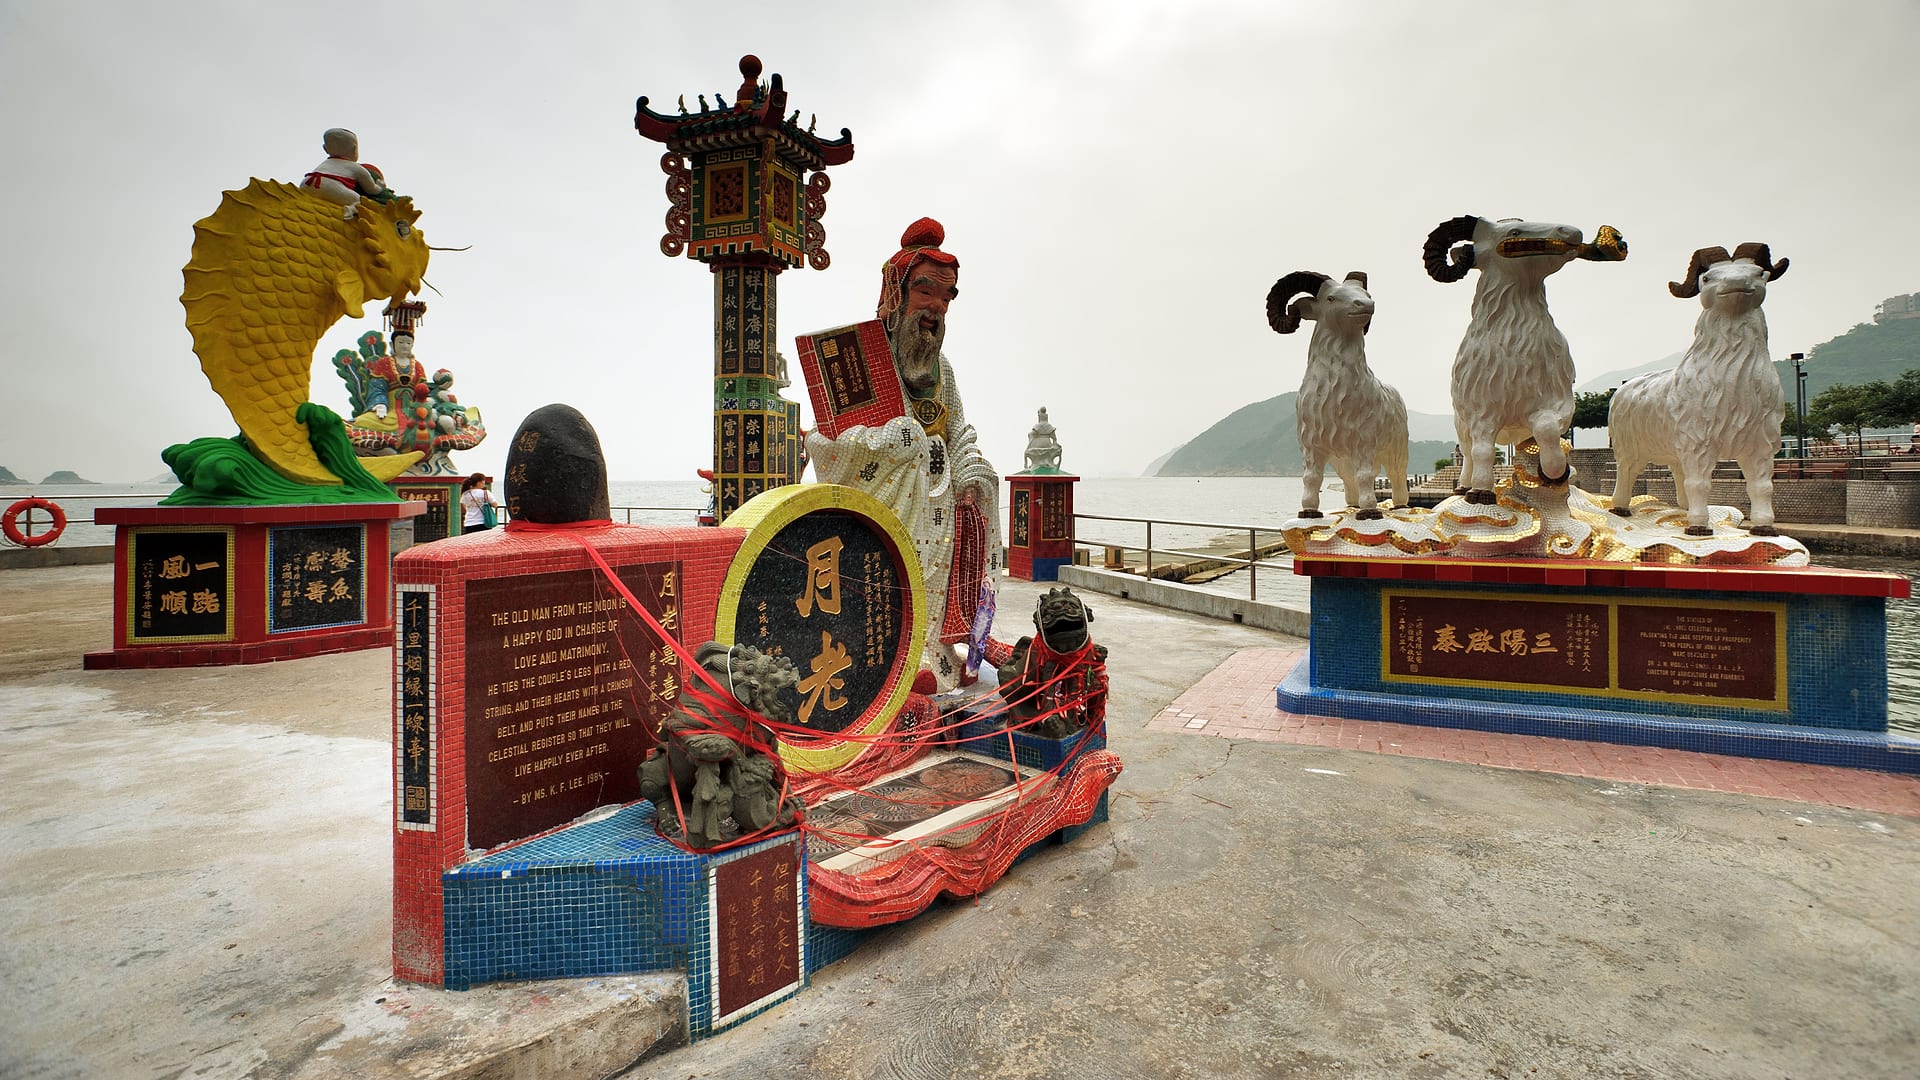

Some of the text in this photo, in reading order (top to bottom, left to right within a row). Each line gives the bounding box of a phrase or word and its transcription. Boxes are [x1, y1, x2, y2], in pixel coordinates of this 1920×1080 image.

[723, 418, 737, 459] 富貴
[746, 418, 762, 459] 榮華
[158, 554, 190, 615] 風順
[491, 597, 627, 626] THE OLD MAN FROM THE MOON IS
[795, 535, 853, 724] 月老
[503, 619, 618, 649] A HAPPY GOD IN CHARGE OF
[514, 641, 609, 670] LOVE AND MATRIMONY.
[487, 683, 499, 697] HE
[501, 680, 519, 693] TIES
[522, 676, 536, 689] THE
[538, 669, 572, 686] COUPLE'S
[573, 666, 592, 679] LEGS
[594, 662, 611, 674] WITH
[612, 661, 617, 671] A
[514, 699, 530, 713] AND
[531, 695, 552, 709] THEIR
[553, 688, 580, 704] HEARTS
[582, 685, 599, 697] WITH
[600, 683, 605, 693] A
[519, 720, 534, 733] AND
[535, 715, 554, 729] PUTS
[556, 710, 576, 724] THEIR
[578, 704, 600, 719] NAMES
[601, 702, 609, 713] IN
[610, 699, 623, 711] THE
[488, 716, 632, 763] CELESTIAL REGISTER SO THAT THEY WILL
[514, 742, 610, 778] LIVE HAPPILY EVER AFTER.
[521, 791, 532, 805] BY
[534, 788, 548, 801] MS.
[550, 784, 558, 796] K.
[560, 782, 567, 793] F.
